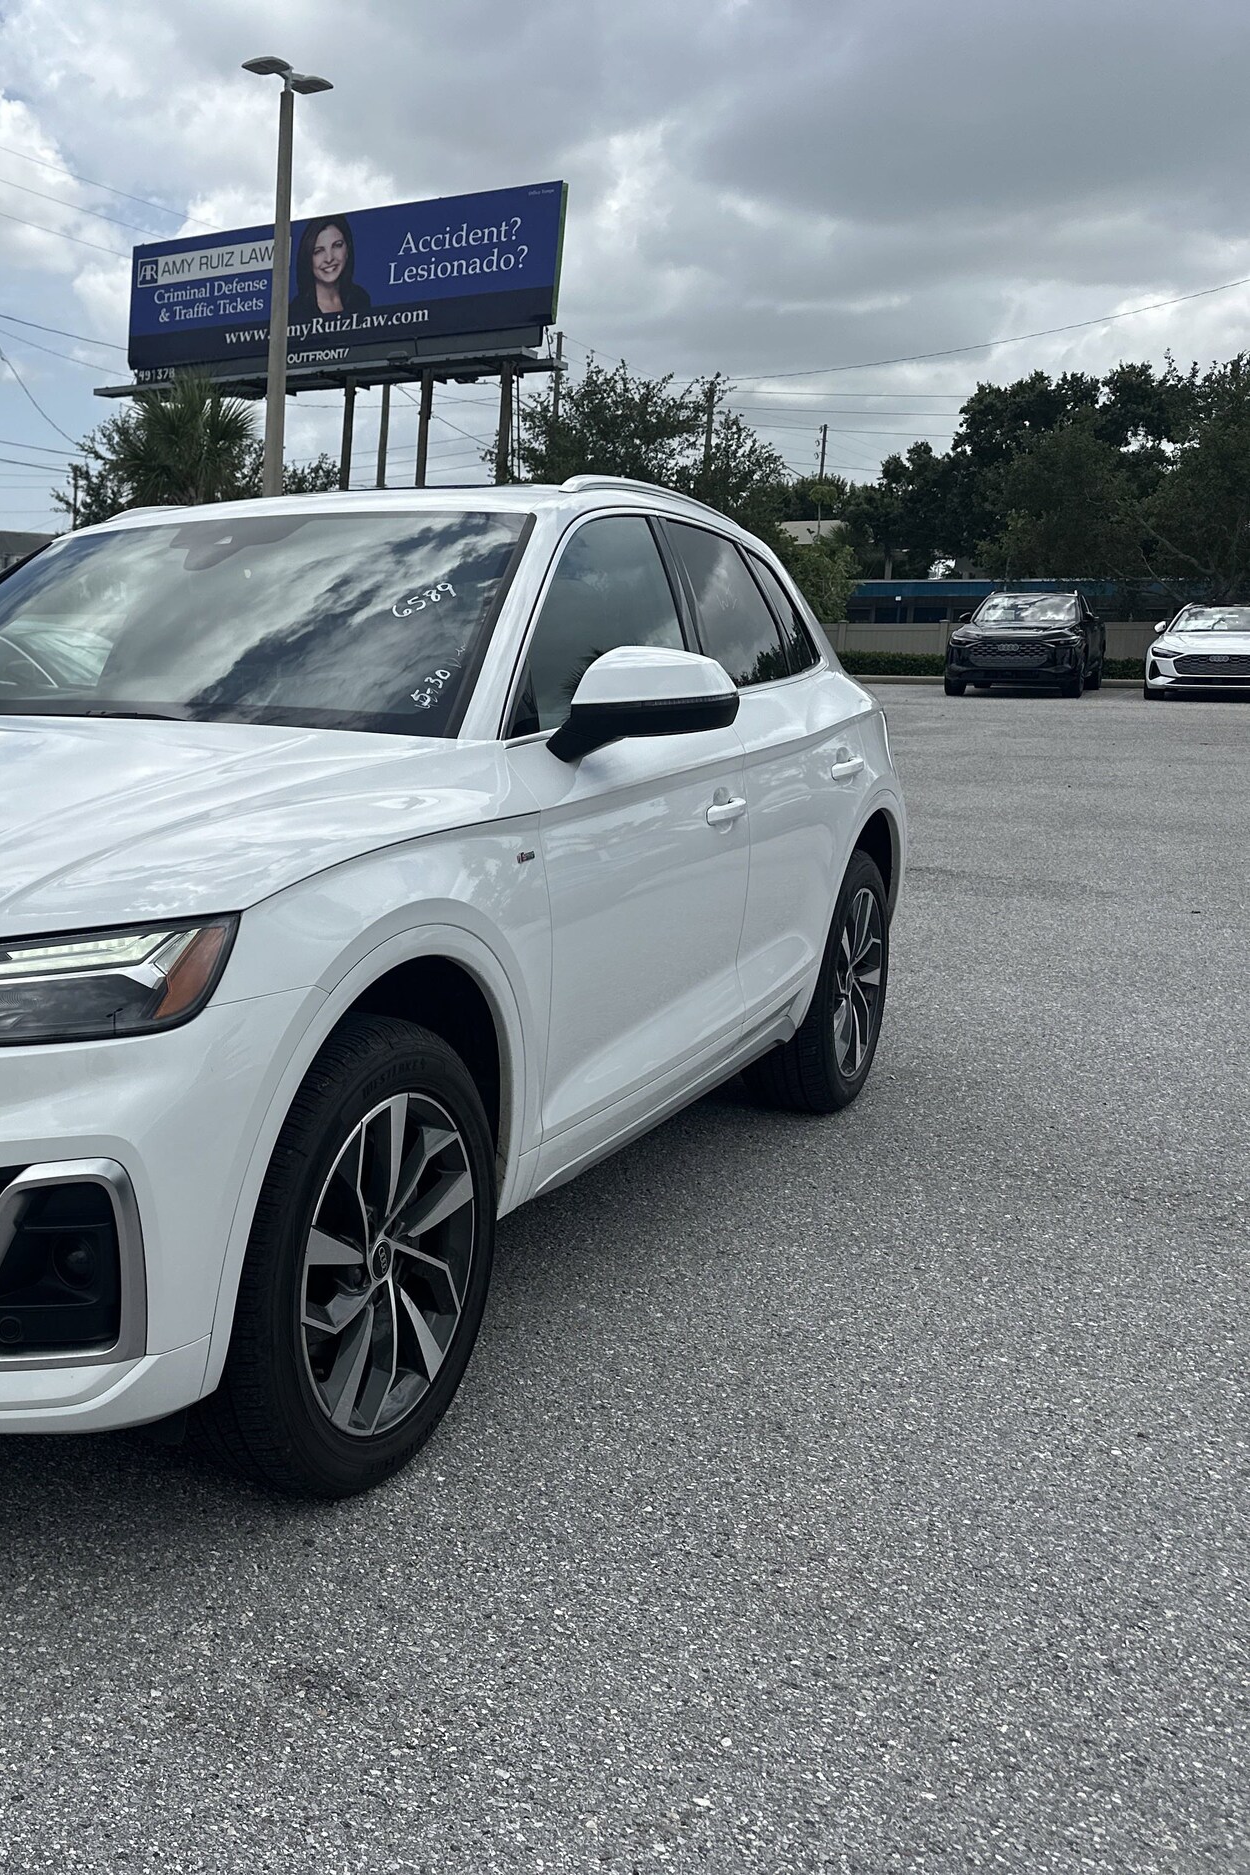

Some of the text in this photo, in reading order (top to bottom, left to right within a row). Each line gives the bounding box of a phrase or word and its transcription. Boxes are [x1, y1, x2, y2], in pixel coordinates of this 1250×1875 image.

[398, 217, 522, 256] Accident?
[161, 245, 275, 277] AMY RUIZ LAW
[389, 245, 529, 285] Lesionado?
[154, 278, 268, 304] Criminal Defense
[159, 298, 264, 323] & Traffic Tickets
[225, 309, 430, 344] www.myRuizLaw.com
[392, 582, 457, 618] 6589
